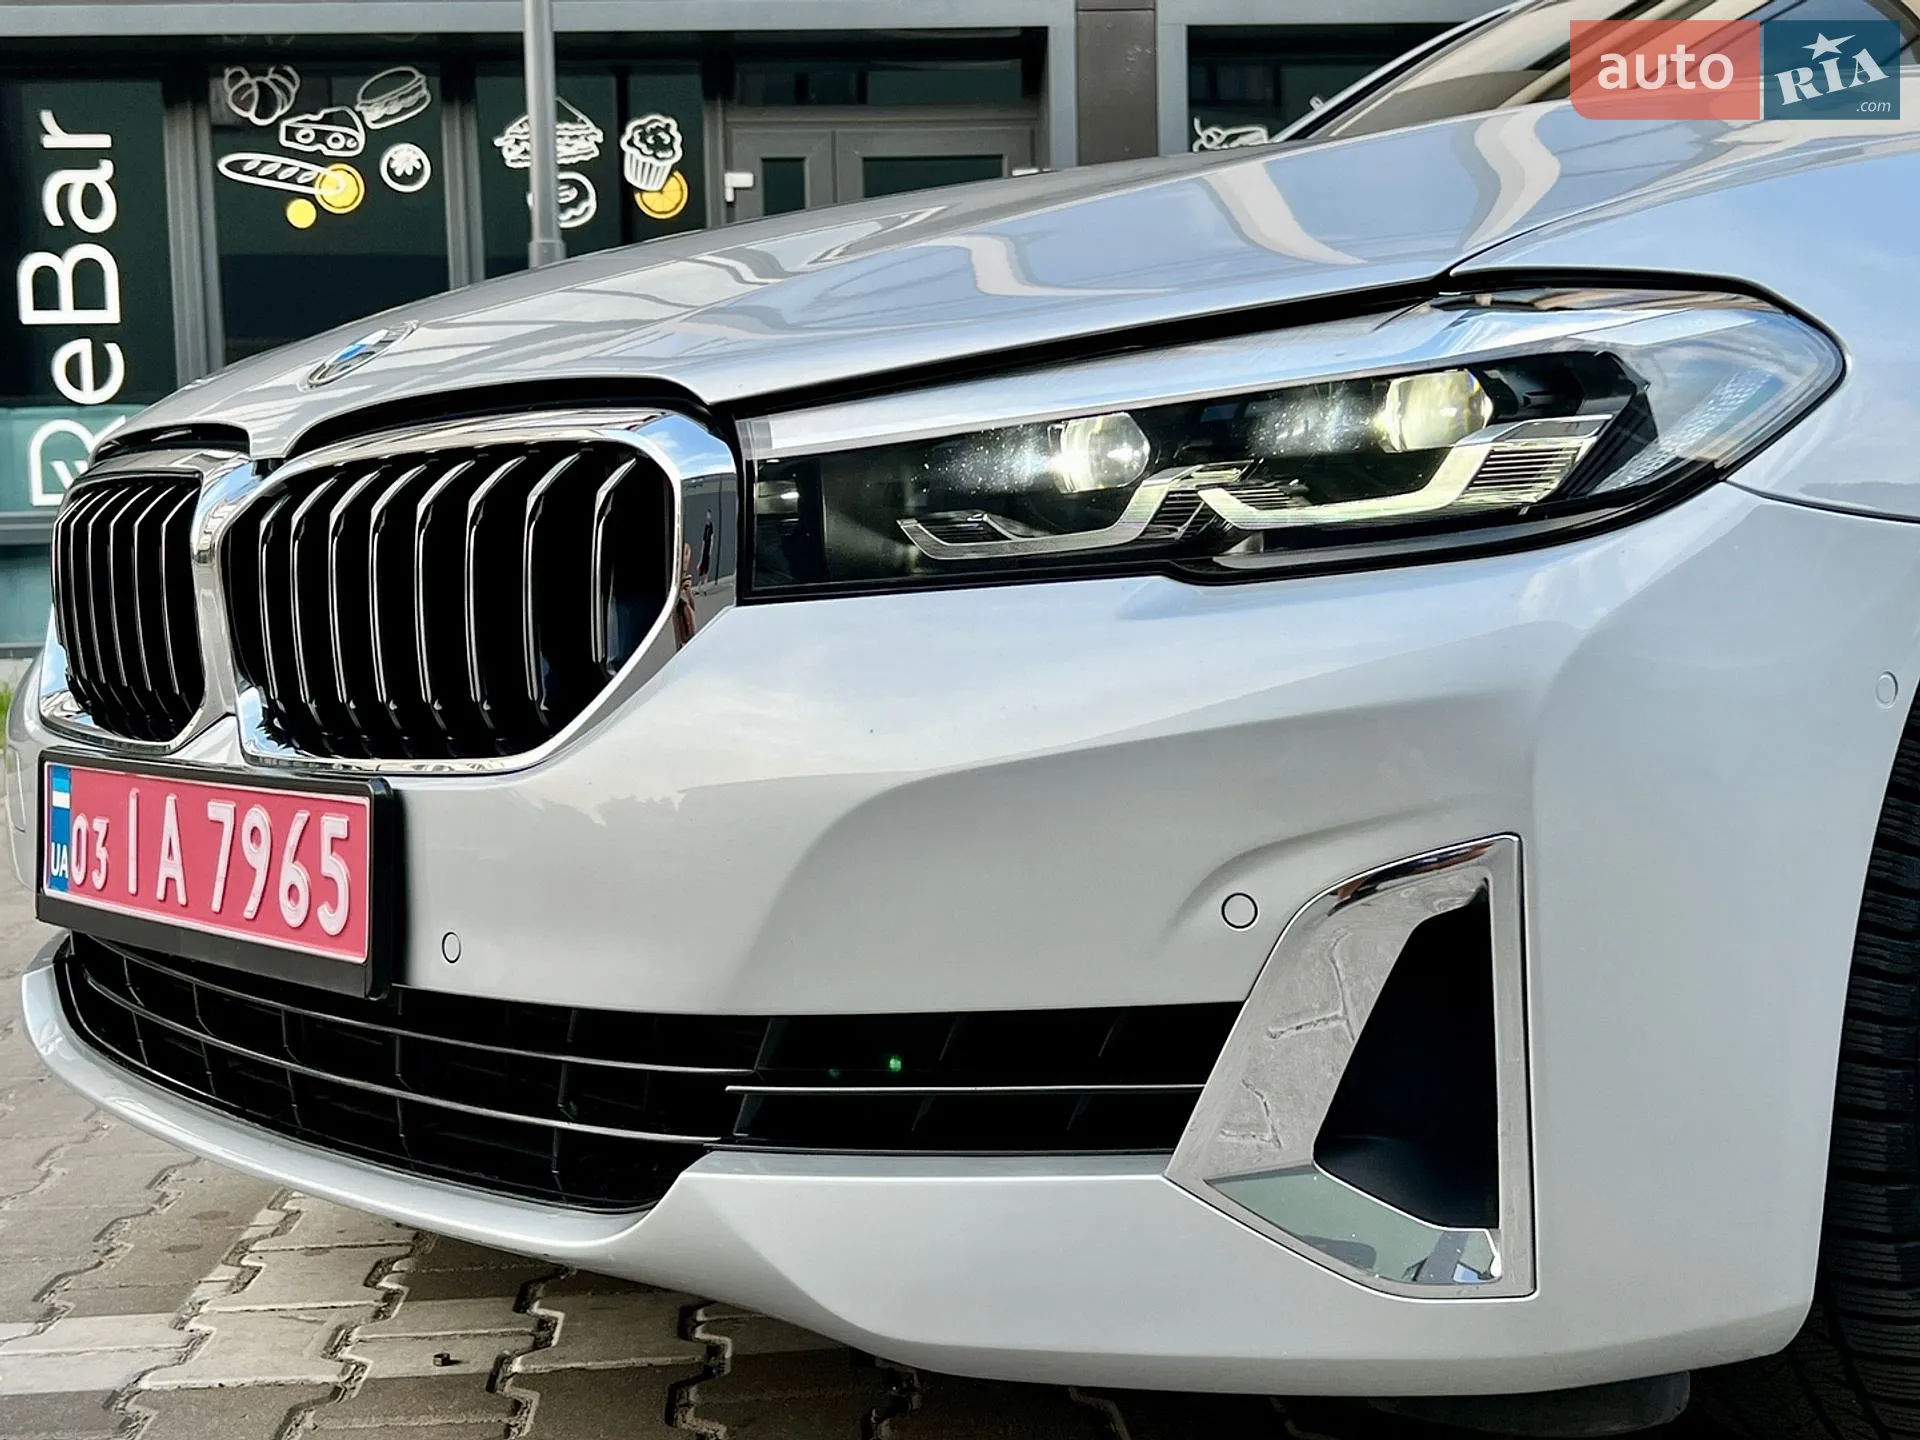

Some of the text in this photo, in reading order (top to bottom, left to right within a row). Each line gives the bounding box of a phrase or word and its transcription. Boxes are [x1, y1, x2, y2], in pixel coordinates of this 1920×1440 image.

[17, 109, 126, 506] ReBar
[51, 842, 70, 879] UA
[71, 787, 351, 936] 03 IA 7965
